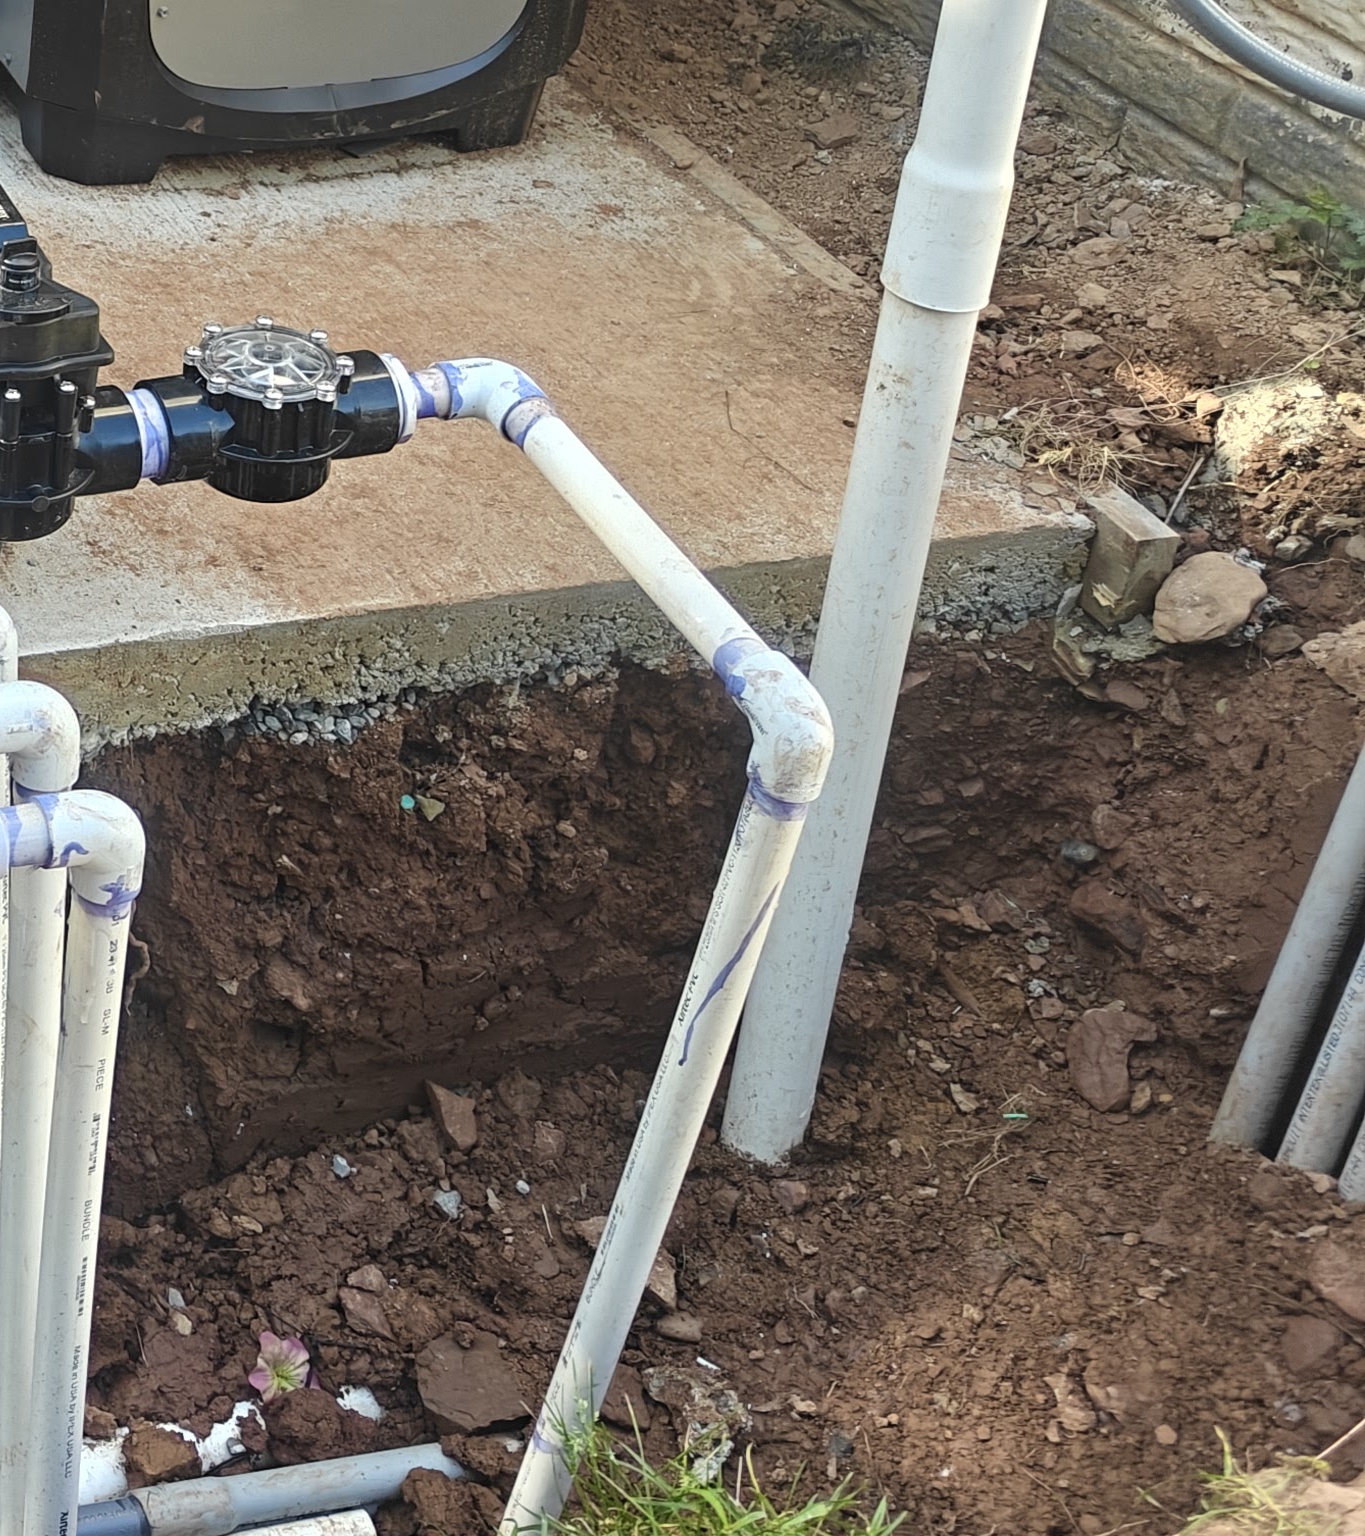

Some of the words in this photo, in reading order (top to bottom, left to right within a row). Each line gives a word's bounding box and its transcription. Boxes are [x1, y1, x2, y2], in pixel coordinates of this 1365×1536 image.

[95, 1058, 107, 1092] PIECE
[81, 1199, 92, 1242] BUNDLE
[70, 1345, 81, 1371] Made
